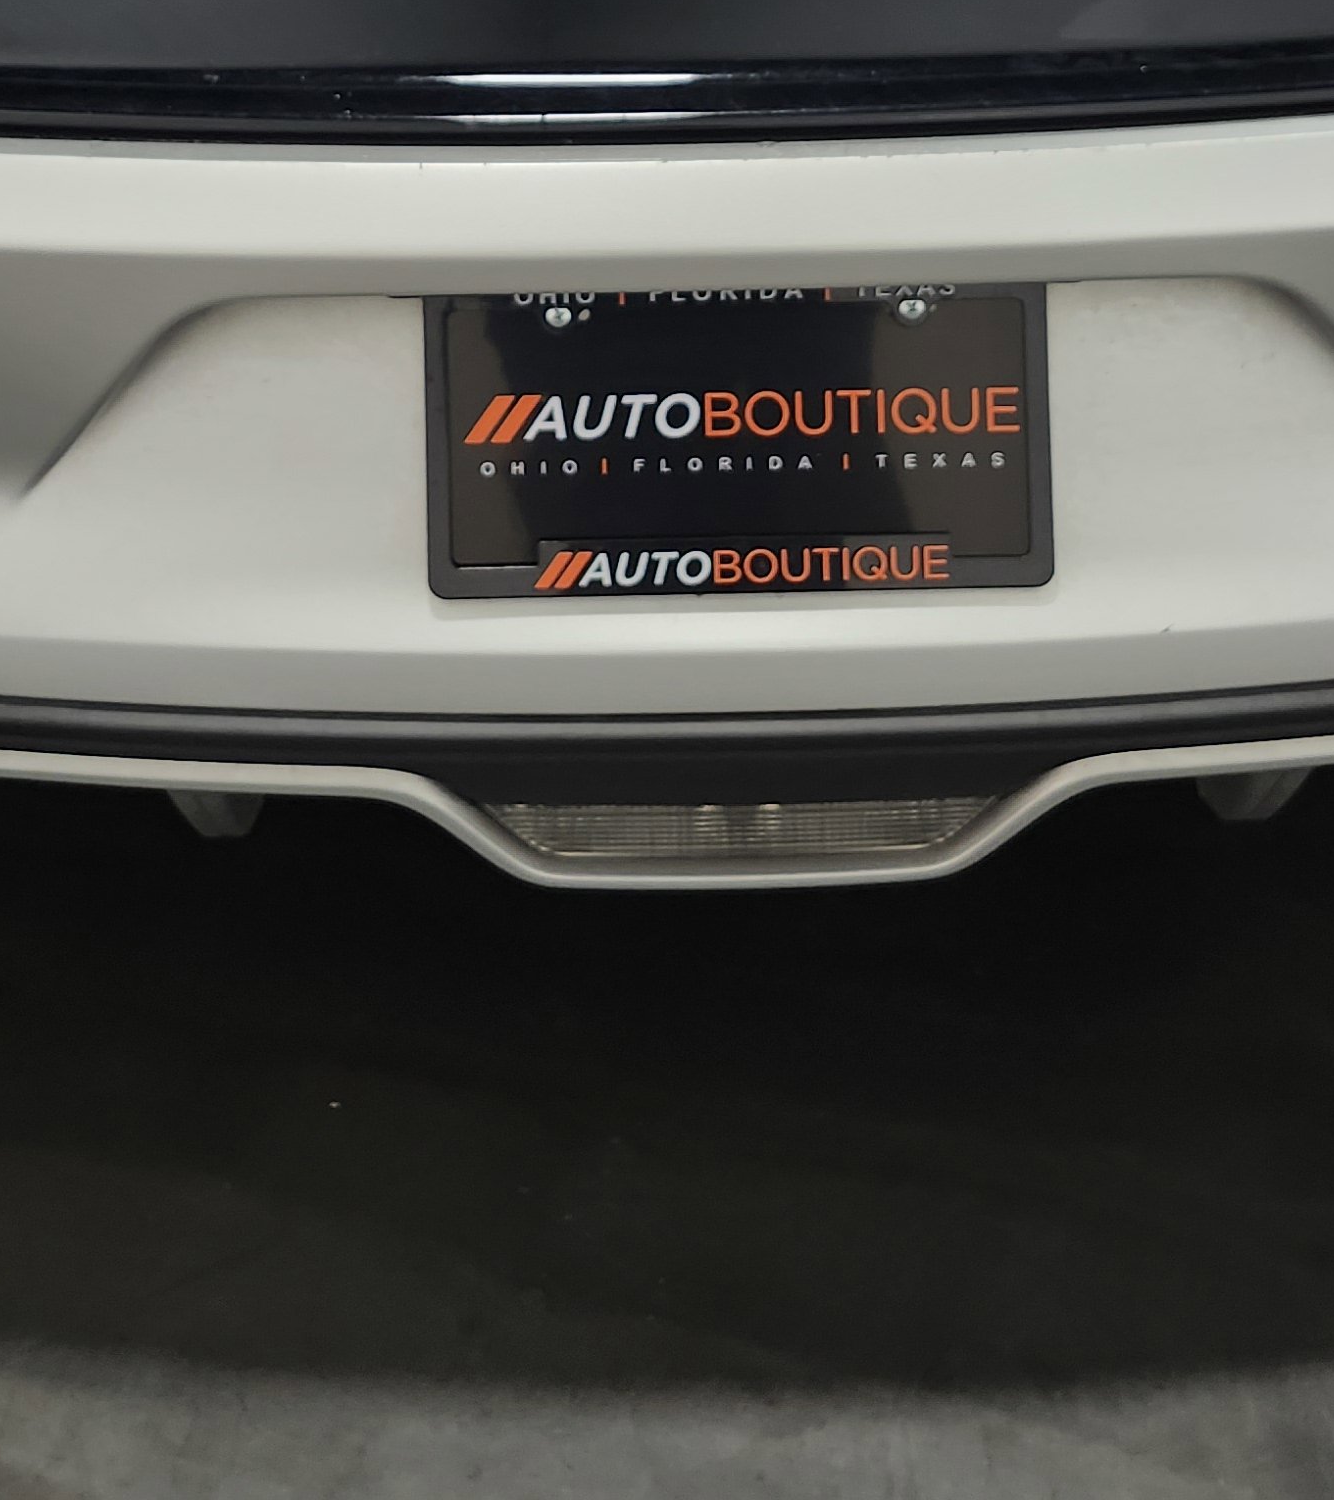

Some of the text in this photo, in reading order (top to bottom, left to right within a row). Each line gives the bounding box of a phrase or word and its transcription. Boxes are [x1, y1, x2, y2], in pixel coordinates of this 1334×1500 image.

[523, 387, 1021, 442] AUTOBOUTIQUE
[479, 451, 1007, 478] OHIO FLORIDA TEXAS
[578, 544, 950, 587] AUTOBOUTIQUE
